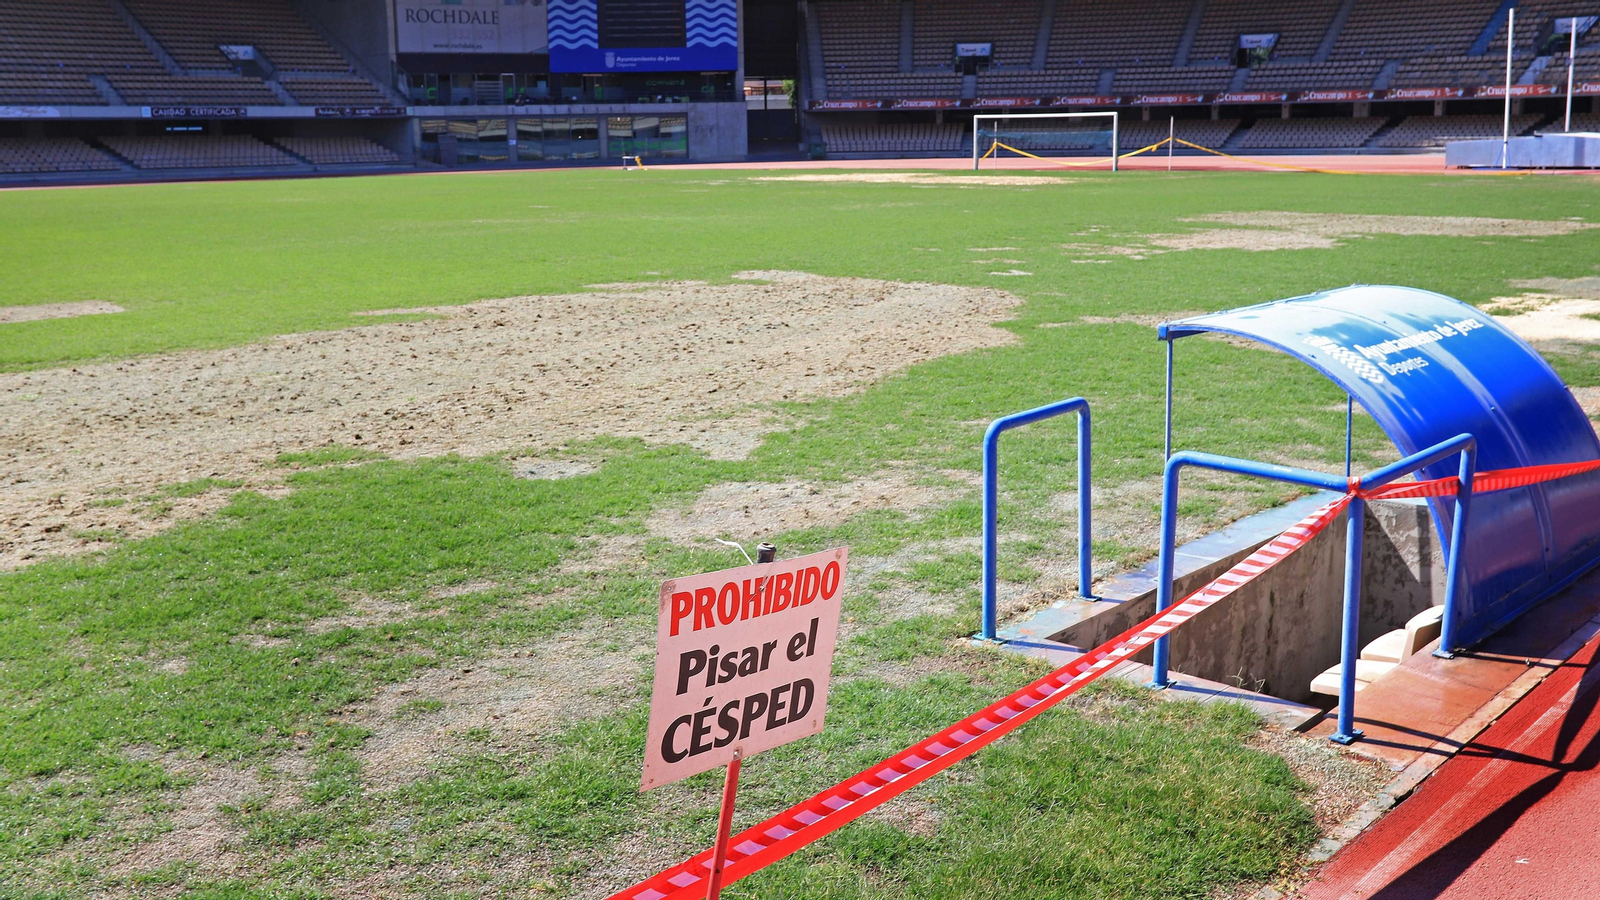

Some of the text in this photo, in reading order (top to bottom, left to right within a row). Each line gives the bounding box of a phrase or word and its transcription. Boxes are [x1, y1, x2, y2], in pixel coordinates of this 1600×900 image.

[405, 8, 499, 25] ROCHDALE
[433, 42, 483, 50] www.rochdale.es
[1224, 93, 1261, 102] Cruzcampo
[1396, 89, 1435, 98] Cruzcampo
[902, 99, 936, 108] Cruzcampo
[981, 98, 1015, 106] Cruzcampo
[1061, 97, 1095, 105] Cruzcampo
[1142, 95, 1178, 103] Cruzcampo
[823, 101, 858, 109] Cruzcampo
[189, 108, 237, 116] CERTIFICADA
[1353, 318, 1484, 361] Ayuntamiento de Jerez
[1378, 356, 1429, 377] Deportes
[669, 560, 841, 637] PROHIBIDO
[676, 616, 820, 696] Pisar el
[660, 677, 815, 765] CÉSPED
